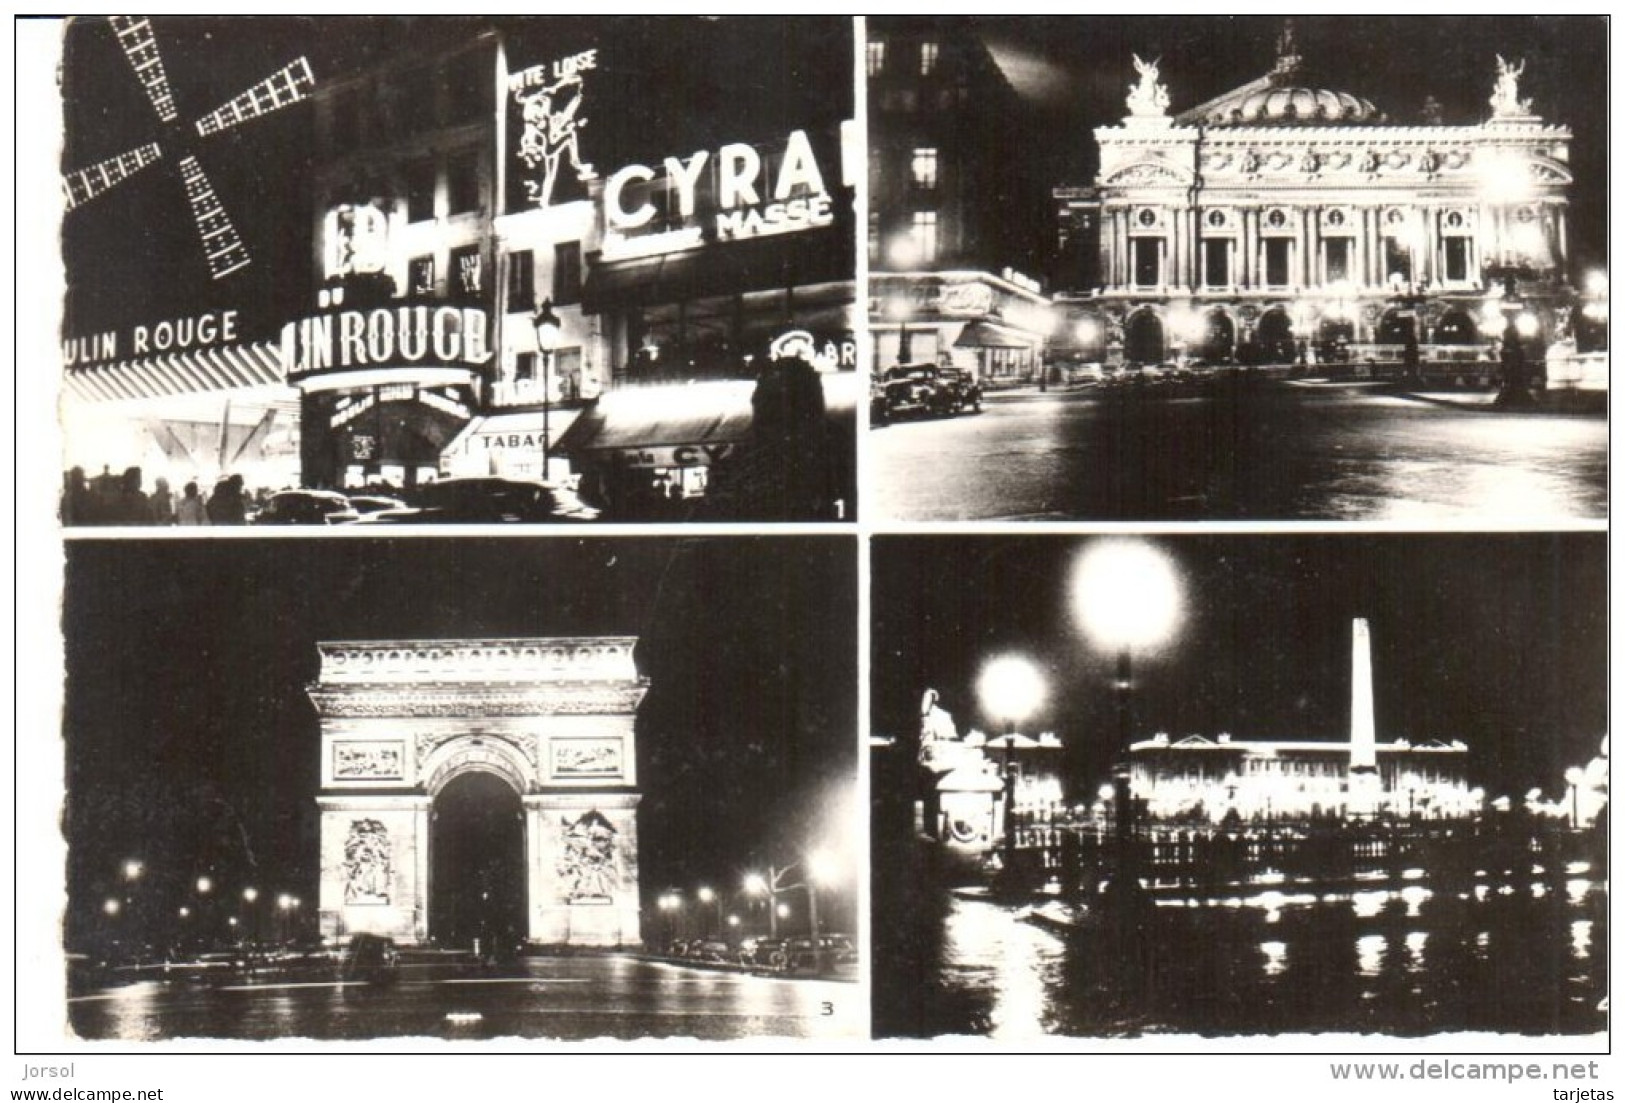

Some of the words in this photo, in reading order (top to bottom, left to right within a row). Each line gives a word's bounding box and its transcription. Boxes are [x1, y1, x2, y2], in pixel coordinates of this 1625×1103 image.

[716, 197, 833, 242] MASSE
[134, 310, 238, 354] ROUGE
[340, 305, 493, 366] ROUGE
[833, 499, 844, 519] 1
[820, 1001, 834, 1016] 3
